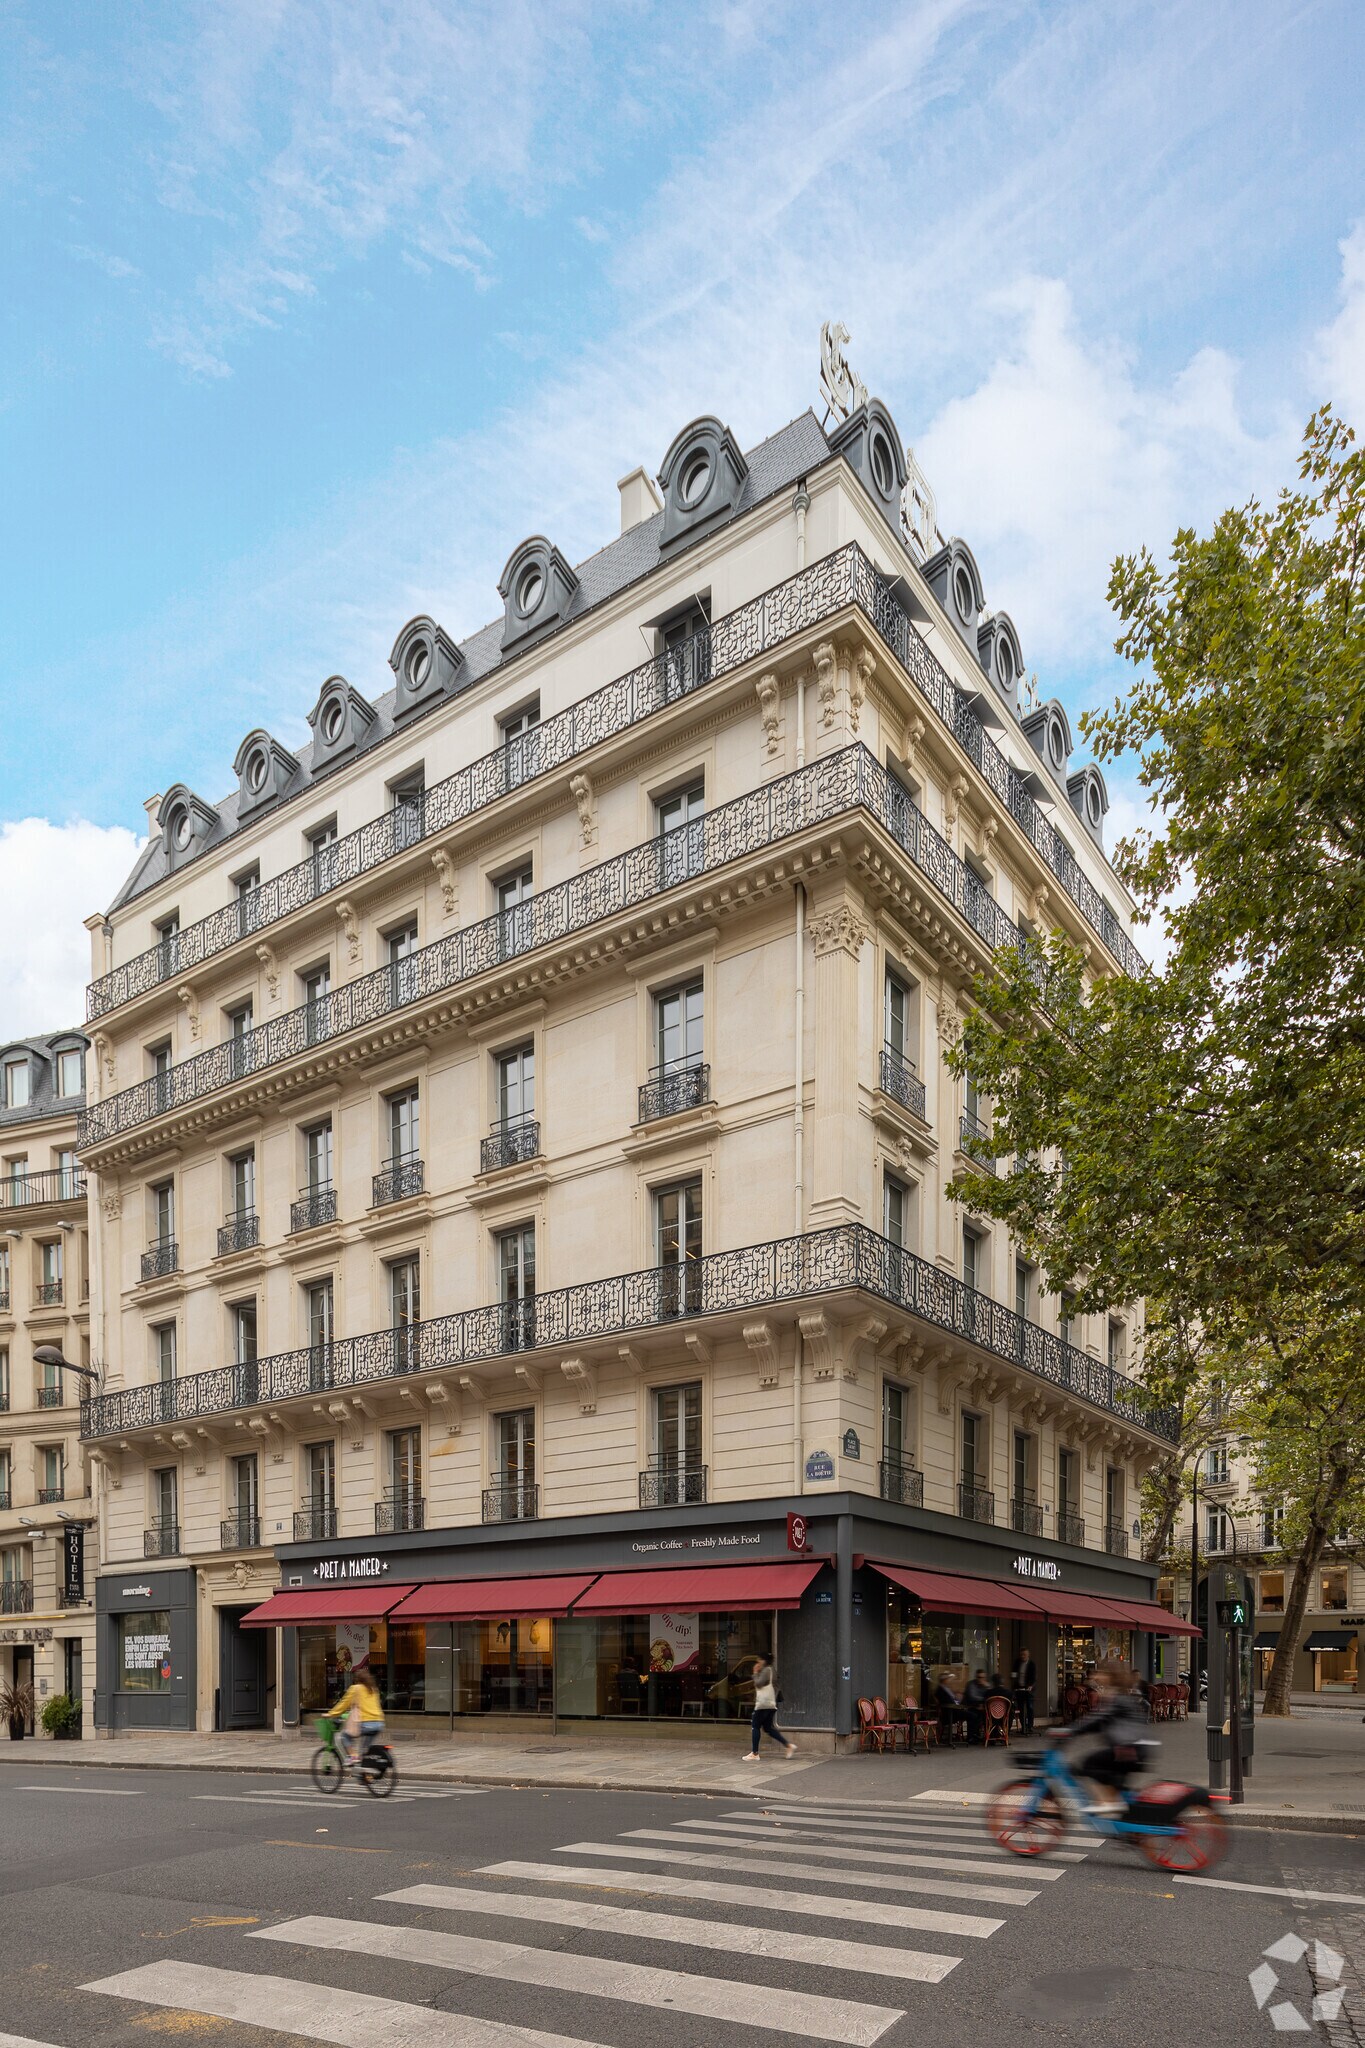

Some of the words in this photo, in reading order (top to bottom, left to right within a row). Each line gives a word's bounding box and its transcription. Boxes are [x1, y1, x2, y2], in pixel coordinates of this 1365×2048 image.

[632, 1541, 659, 1553] Organic
[660, 1540, 682, 1550] Coffee
[692, 1538, 716, 1548] Freshly
[718, 1536, 739, 1546] Made
[741, 1534, 760, 1544] Food
[70, 1536, 78, 1582] HÔTEL
[320, 1561, 338, 1579] PRET
[341, 1561, 346, 1577] A
[349, 1558, 380, 1577] MANGER
[1018, 1556, 1032, 1576] PRET
[1032, 1560, 1036, 1577] A
[1037, 1560, 1057, 1580] MANGER
[675, 1625, 692, 1636] dip!
[134, 1636, 144, 1644] VOS
[125, 1652, 134, 1661] QUI
[125, 1660, 134, 1668] LES
